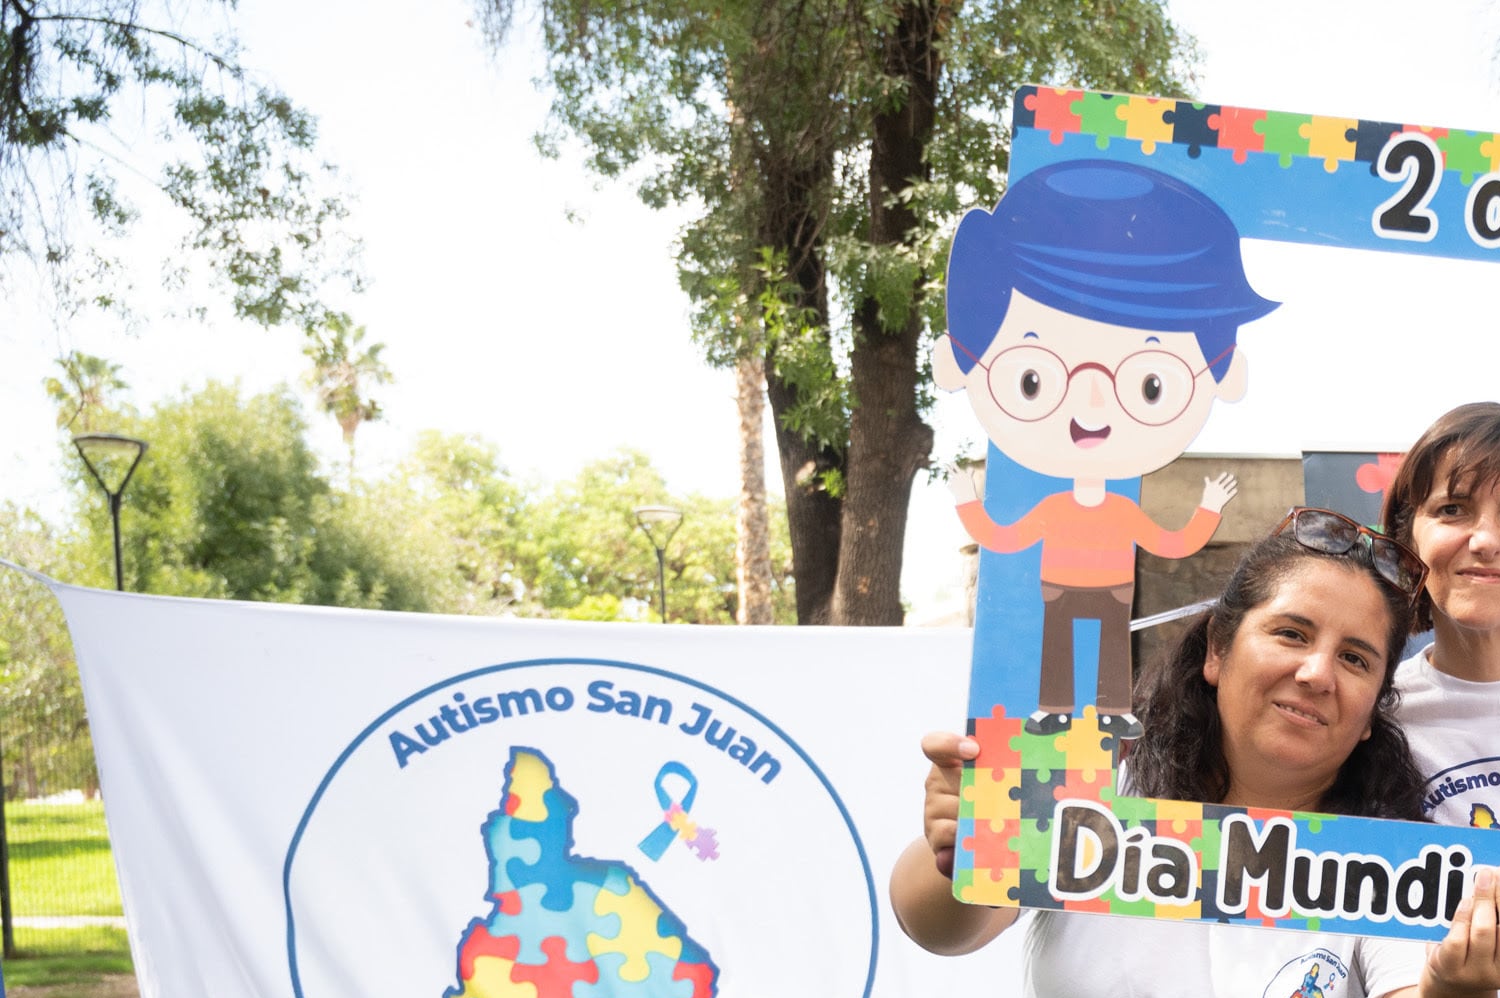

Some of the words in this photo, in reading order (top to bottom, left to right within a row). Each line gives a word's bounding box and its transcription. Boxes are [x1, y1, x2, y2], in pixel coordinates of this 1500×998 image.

[1378, 140, 1436, 235] 2
[387, 685, 575, 769] Autismo
[586, 679, 673, 725] San
[678, 701, 783, 785] Juan
[1055, 804, 1190, 900] Día
